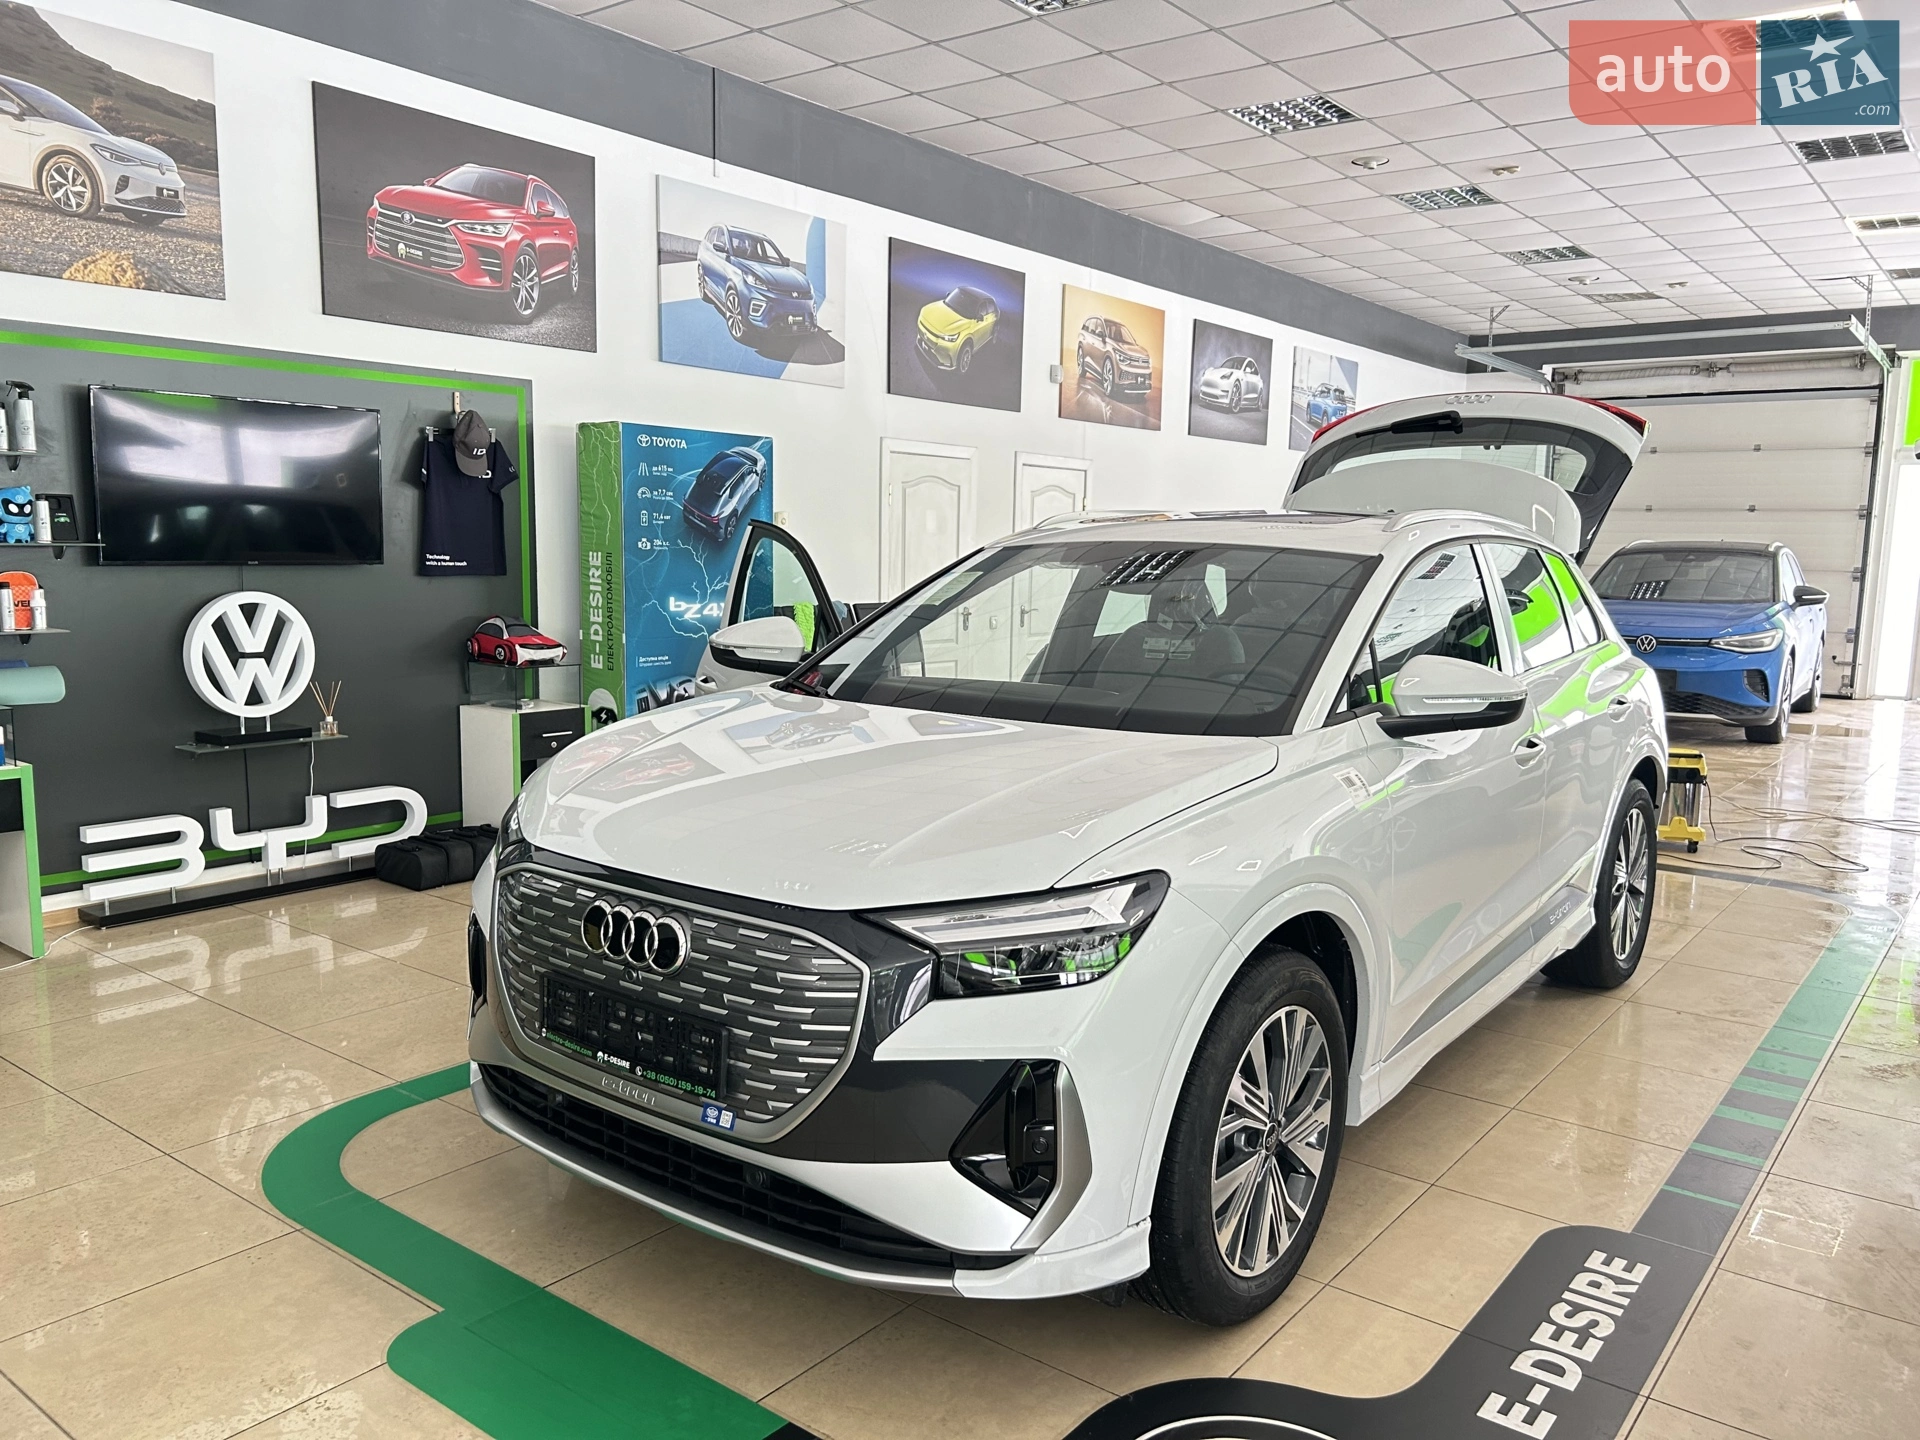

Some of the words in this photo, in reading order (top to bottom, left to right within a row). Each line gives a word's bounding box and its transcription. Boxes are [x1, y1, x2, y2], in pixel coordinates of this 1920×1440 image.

[472, 447, 487, 456] ID
[651, 436, 688, 449] TOYOTA
[425, 553, 450, 561] Technology
[589, 551, 603, 669] E-DESIRE
[606, 552, 614, 671] ЕЛЕКТРОАВТОМОБІЛІ
[79, 785, 428, 901] BYD
[603, 1053, 631, 1069] E-DESIRE
[643, 1069, 656, 1080] +38
[656, 1074, 678, 1087] (050)
[677, 1080, 717, 1099] 159-19-74
[1476, 1249, 1652, 1440] E-DESIRE
